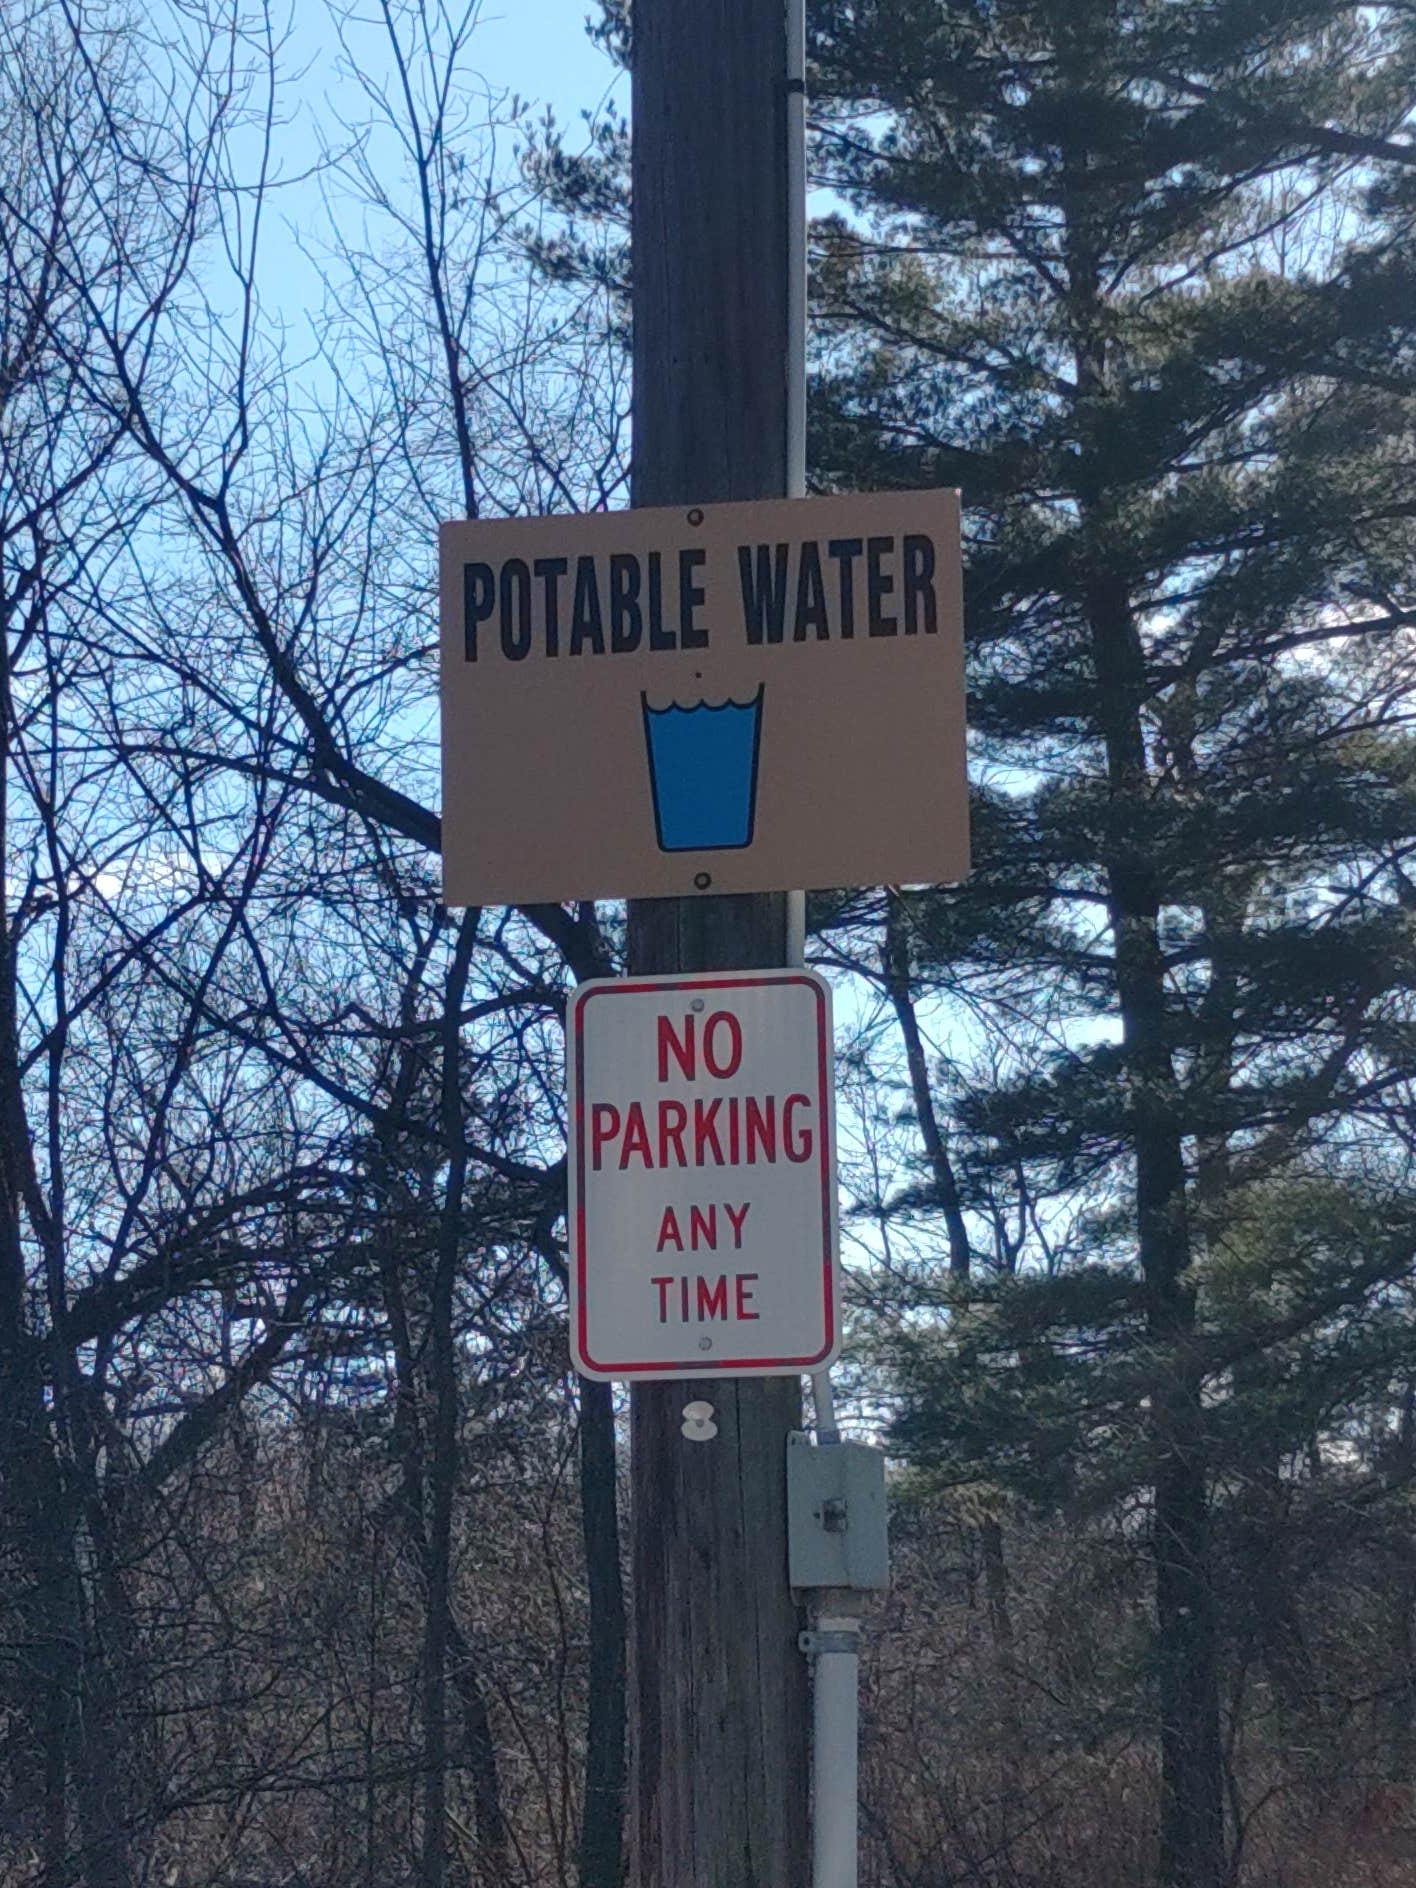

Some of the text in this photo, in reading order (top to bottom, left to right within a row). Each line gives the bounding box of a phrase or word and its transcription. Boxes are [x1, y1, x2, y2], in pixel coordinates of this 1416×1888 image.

[463, 534, 938, 662] POTABLE WATER
[657, 1011, 743, 1082] NO
[592, 1094, 812, 1170] PARKING
[656, 1202, 751, 1252] ANY
[651, 1273, 760, 1323] TIME
